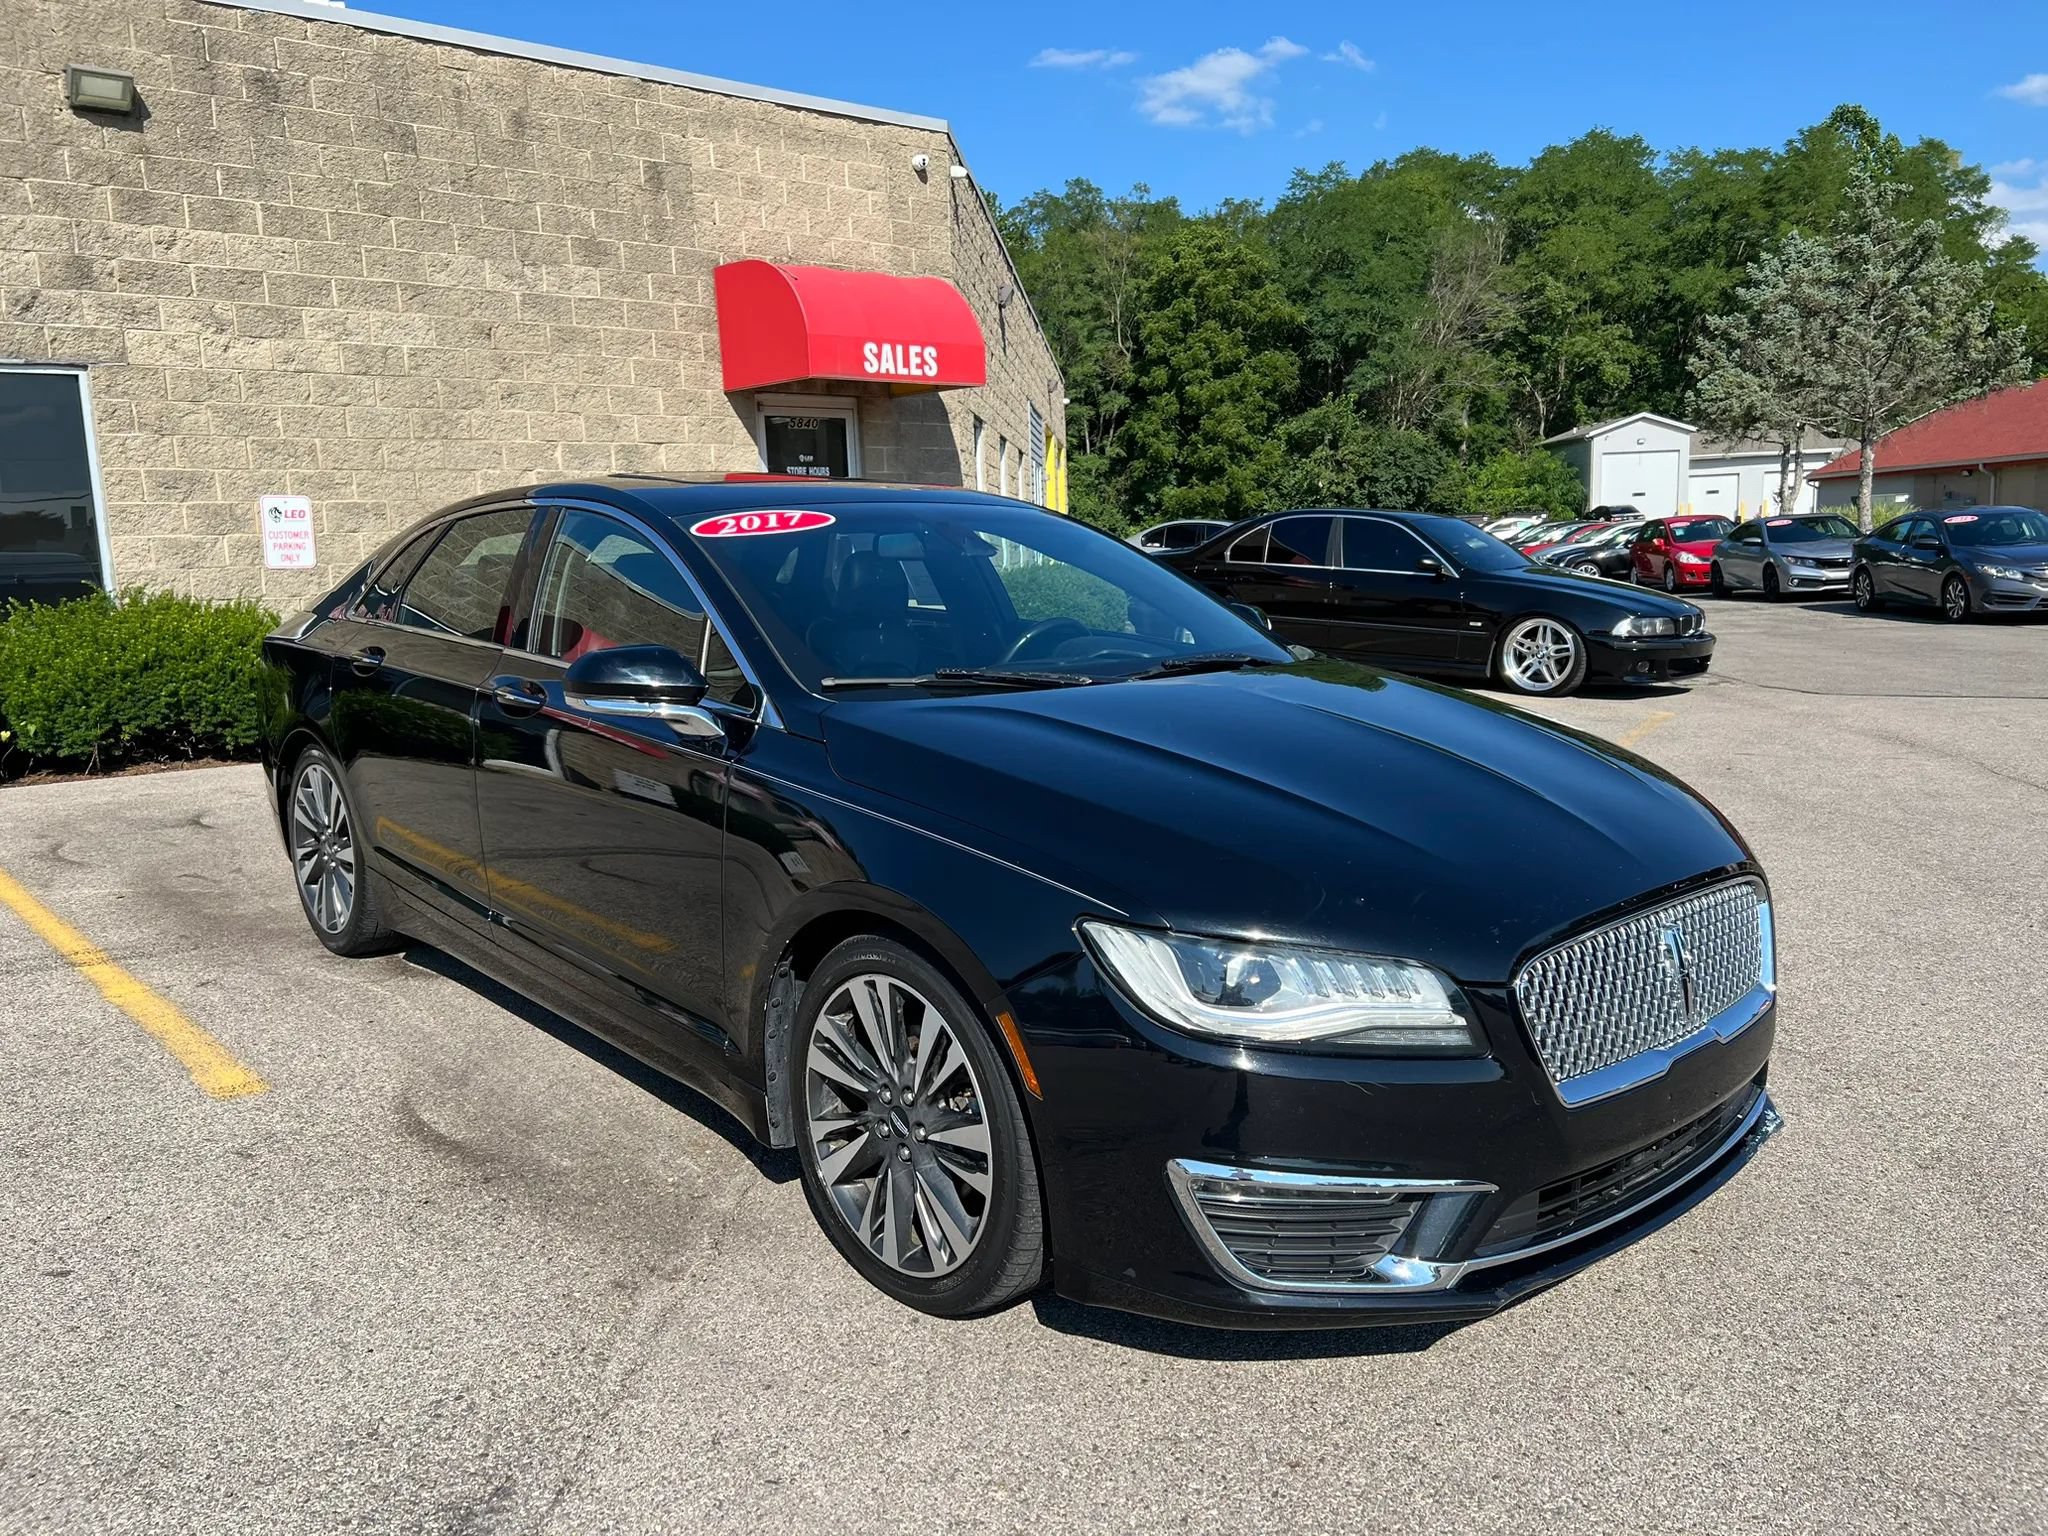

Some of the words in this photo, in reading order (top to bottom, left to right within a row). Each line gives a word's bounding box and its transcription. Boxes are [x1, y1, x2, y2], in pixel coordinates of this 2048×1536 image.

[863, 341, 938, 377] SALES
[788, 417, 819, 429] 5840
[786, 466, 807, 475] STORE
[808, 467, 830, 476] HOURS
[284, 509, 306, 519] LEO
[717, 511, 803, 534] 2017
[268, 531, 310, 540] CUSTOMER
[273, 542, 307, 551] PARKING
[281, 554, 301, 562] ONLY
